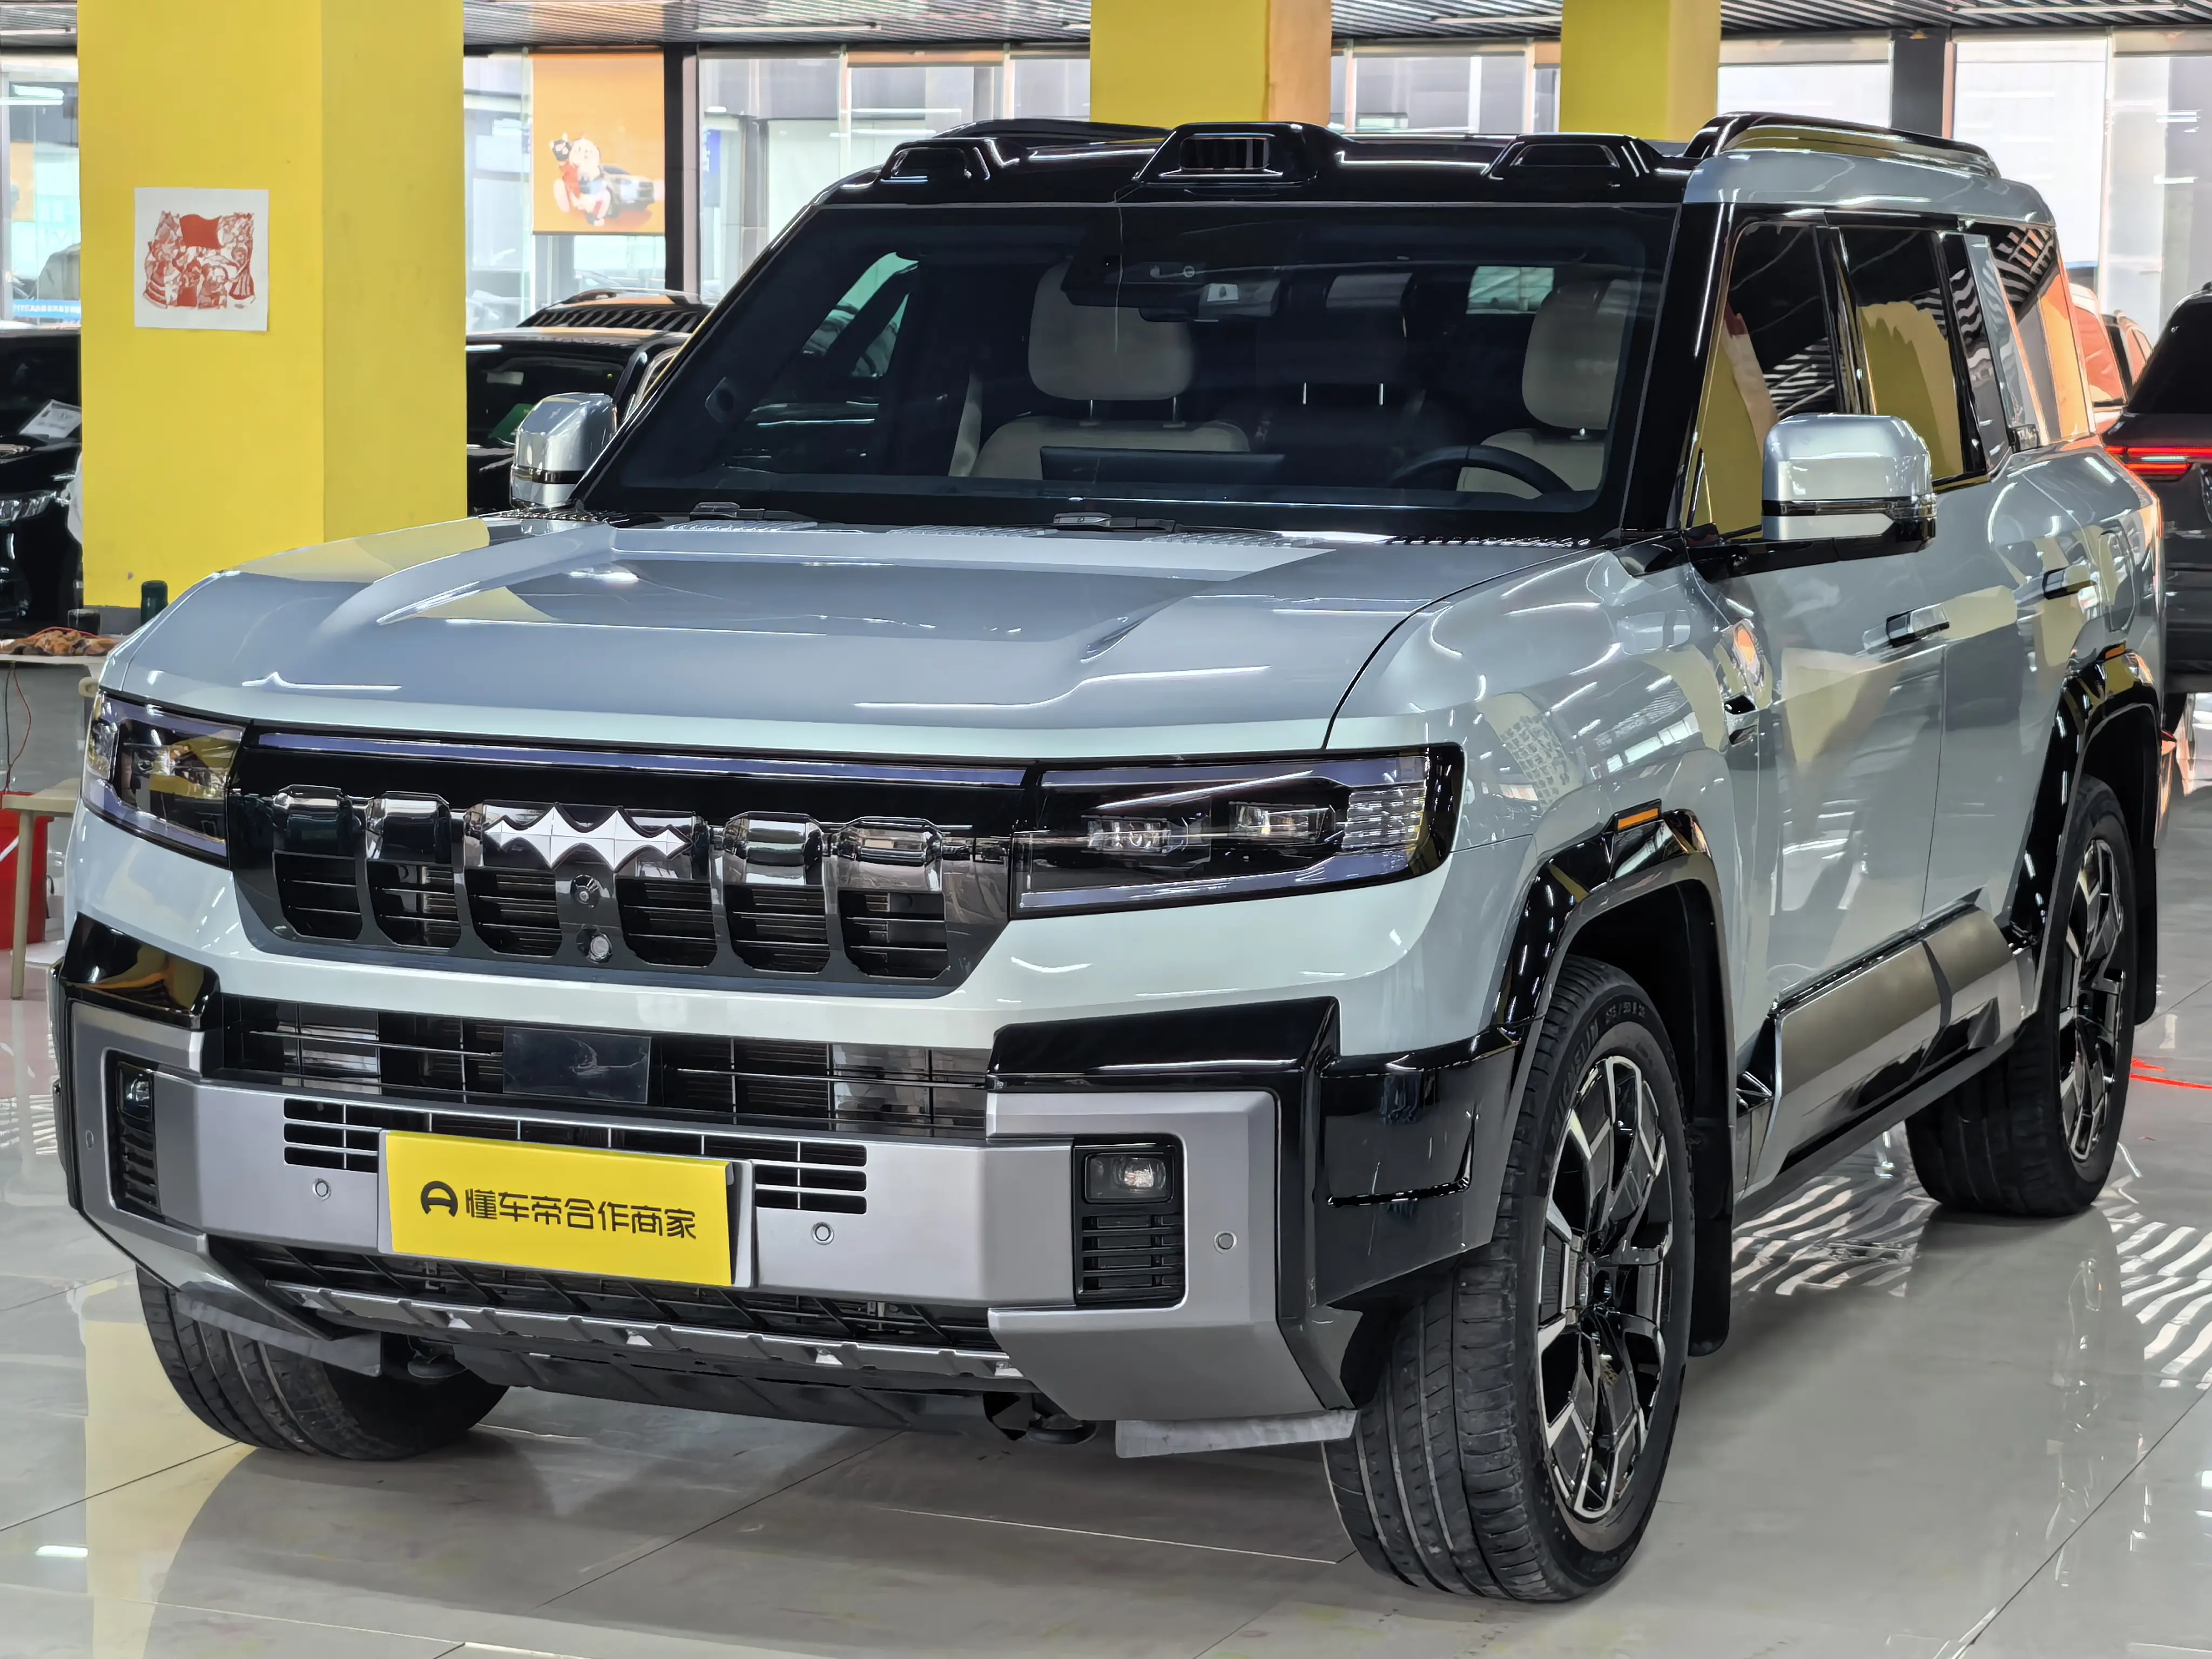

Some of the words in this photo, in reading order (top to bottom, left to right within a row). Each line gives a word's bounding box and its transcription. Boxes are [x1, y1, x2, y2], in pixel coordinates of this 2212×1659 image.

[465, 1188, 696, 1239] 懂车帝合作商家
